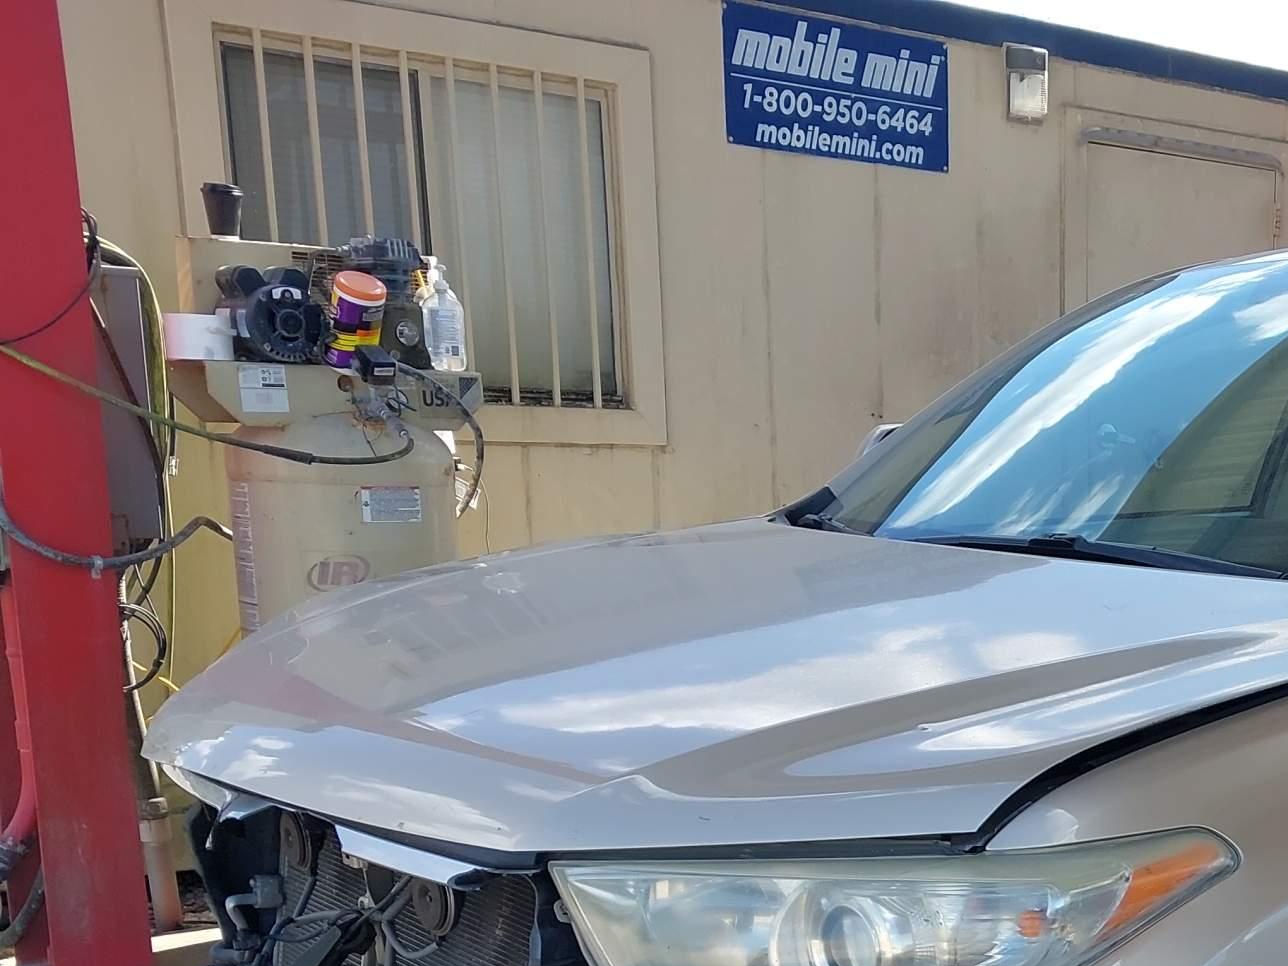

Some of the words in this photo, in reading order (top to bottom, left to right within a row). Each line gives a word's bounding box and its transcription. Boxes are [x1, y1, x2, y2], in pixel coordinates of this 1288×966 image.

[731, 20, 858, 84] mobile
[861, 49, 941, 98] mini
[743, 83, 933, 136] 1-800-950-6464
[755, 122, 925, 164] mobilemini.com
[422, 390, 449, 407] US
